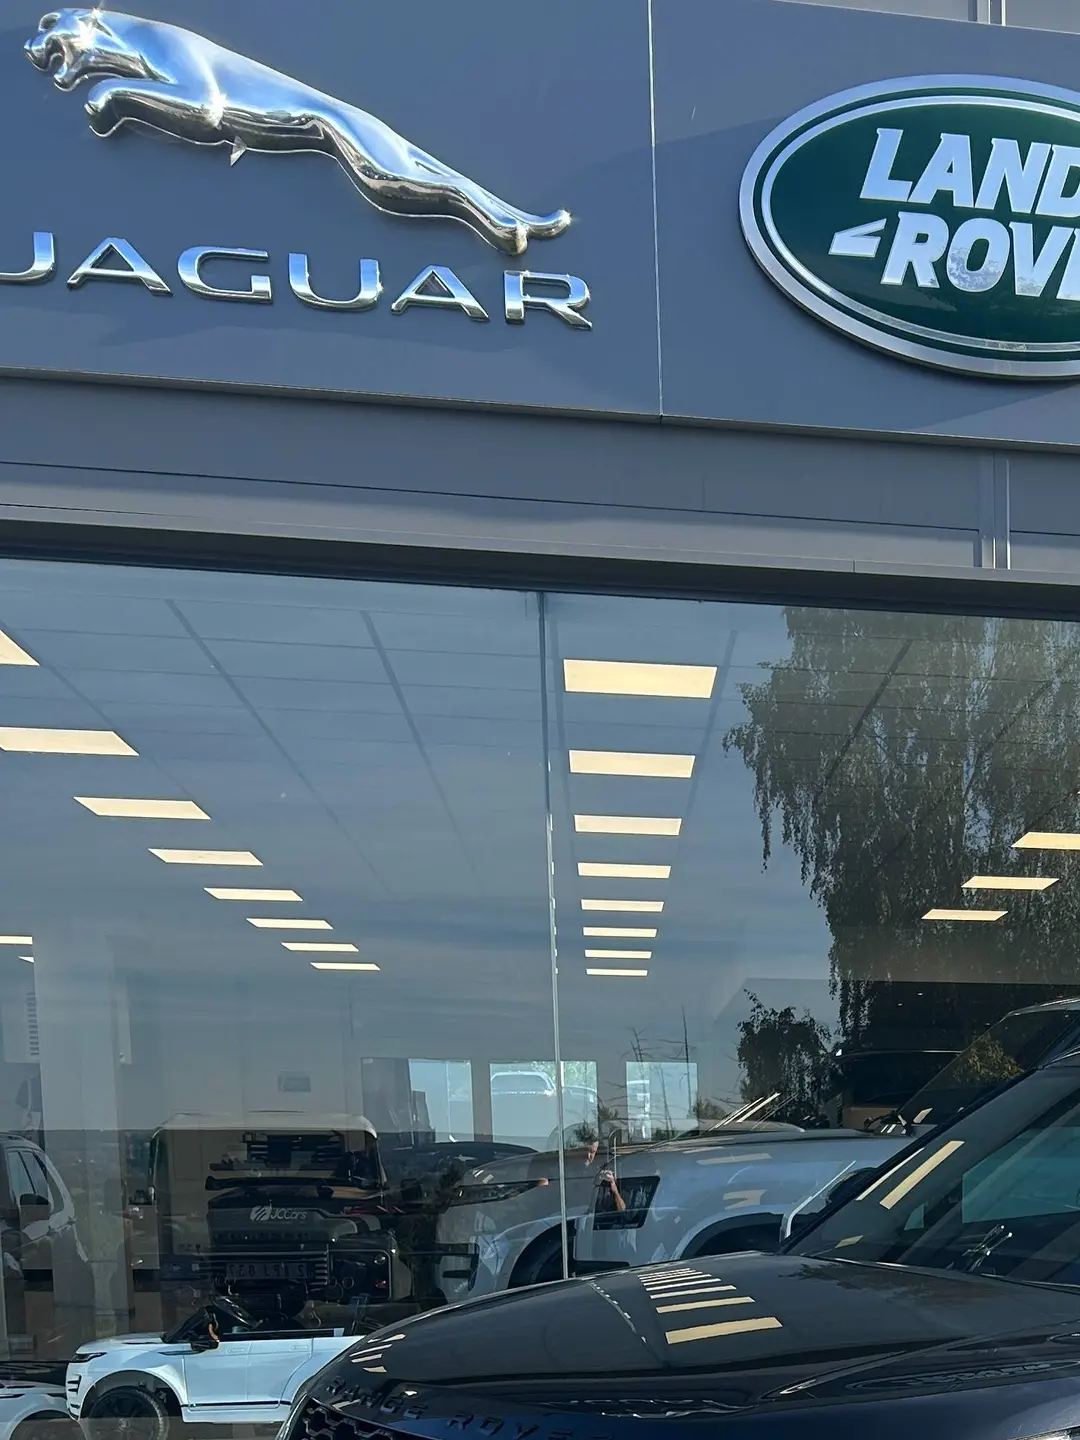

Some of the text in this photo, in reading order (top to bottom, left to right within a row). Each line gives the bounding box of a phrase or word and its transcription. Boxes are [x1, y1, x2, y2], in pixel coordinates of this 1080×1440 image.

[0, 231, 592, 330] JAGUAR
[270, 1207, 308, 1220] JCCars
[326, 1375, 429, 1420] RANGE
